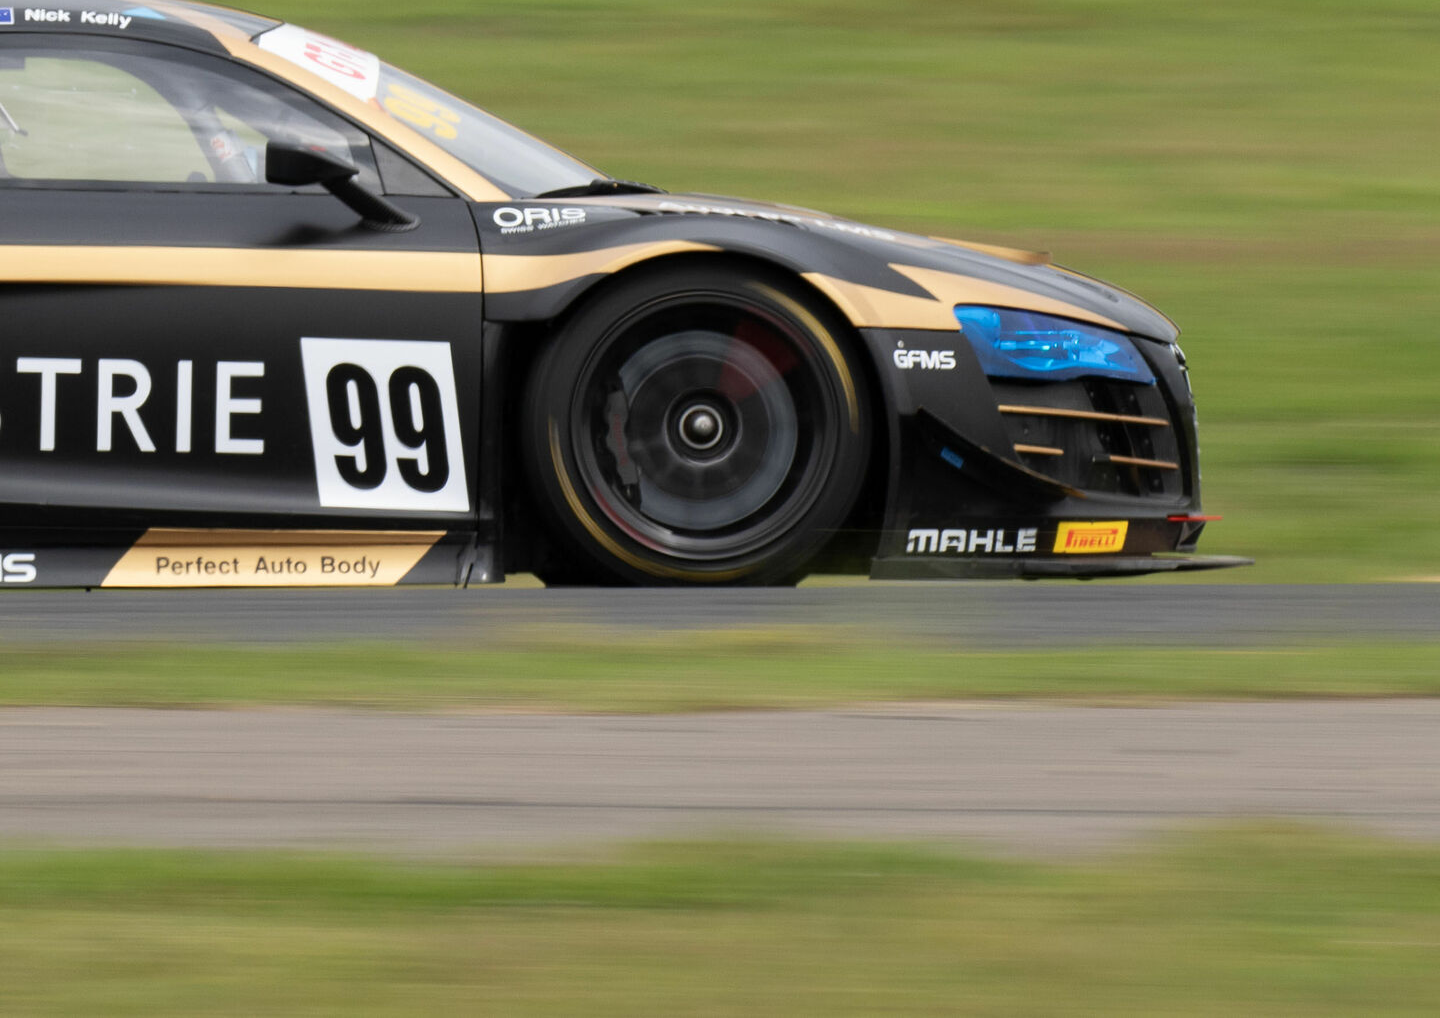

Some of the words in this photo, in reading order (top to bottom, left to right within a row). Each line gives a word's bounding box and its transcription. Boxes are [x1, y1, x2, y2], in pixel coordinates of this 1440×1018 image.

[24, 8, 71, 22] Nick
[81, 10, 131, 29] Kelly
[493, 207, 586, 228] ORIS
[893, 349, 957, 370] GFMS
[324, 361, 451, 494] 99
[906, 528, 1037, 553] MAHLE
[1065, 529, 1118, 548] PIRELLI
[156, 556, 239, 575] Perfect
[254, 556, 307, 575] Auto
[320, 555, 380, 578] Body
